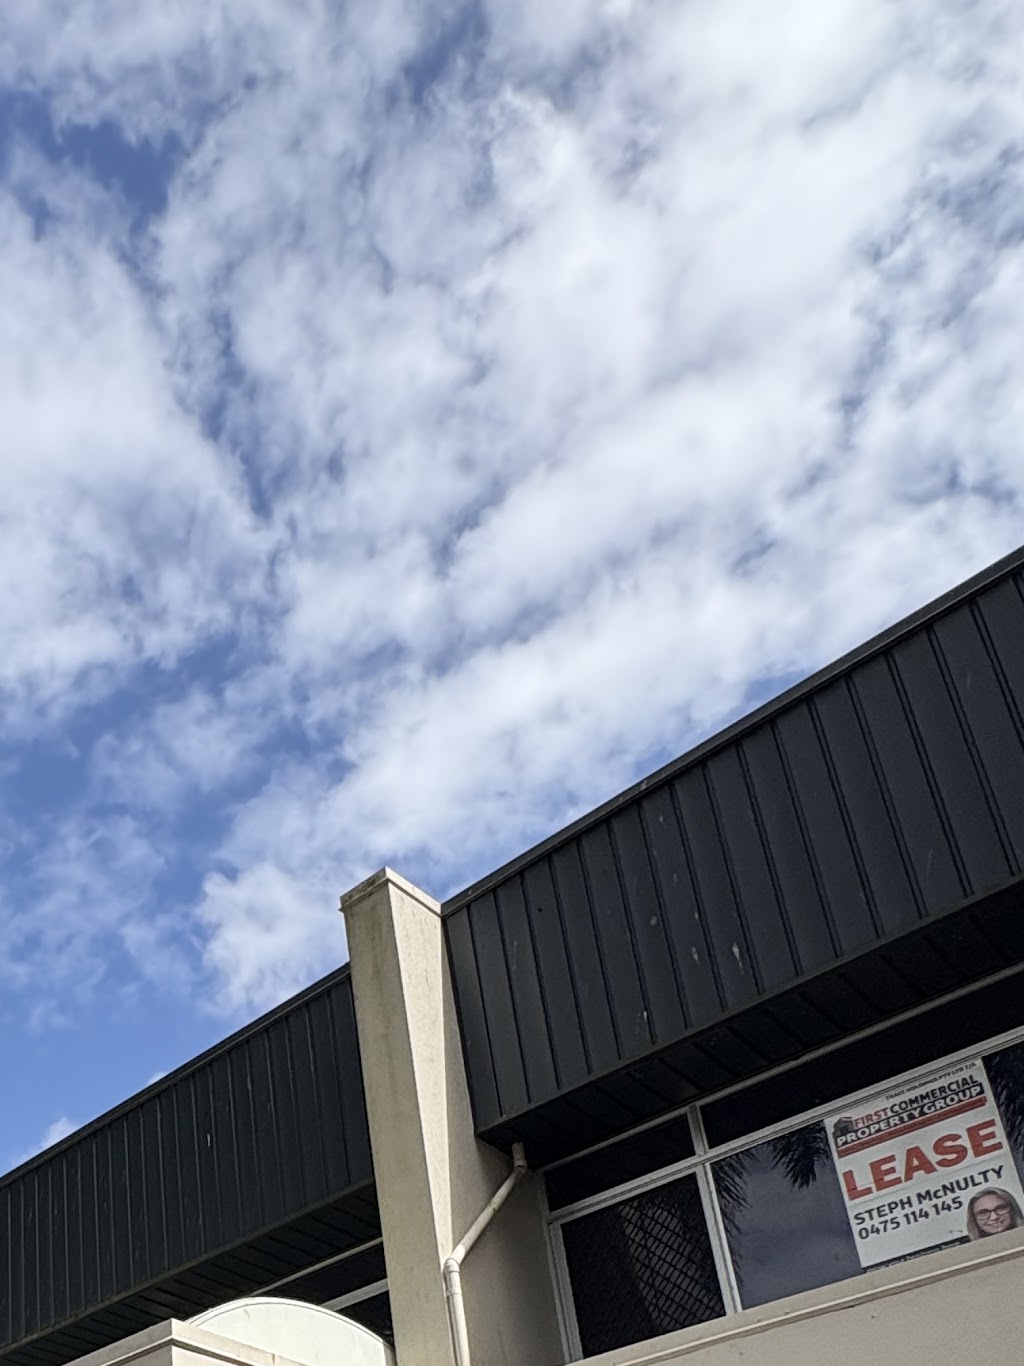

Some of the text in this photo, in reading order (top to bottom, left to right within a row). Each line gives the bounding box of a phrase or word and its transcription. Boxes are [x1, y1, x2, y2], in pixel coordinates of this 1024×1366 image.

[842, 1119, 1004, 1201] LEASE
[853, 1164, 1005, 1226] STEPH McNULTY
[858, 1196, 963, 1240] 0475 114 145
